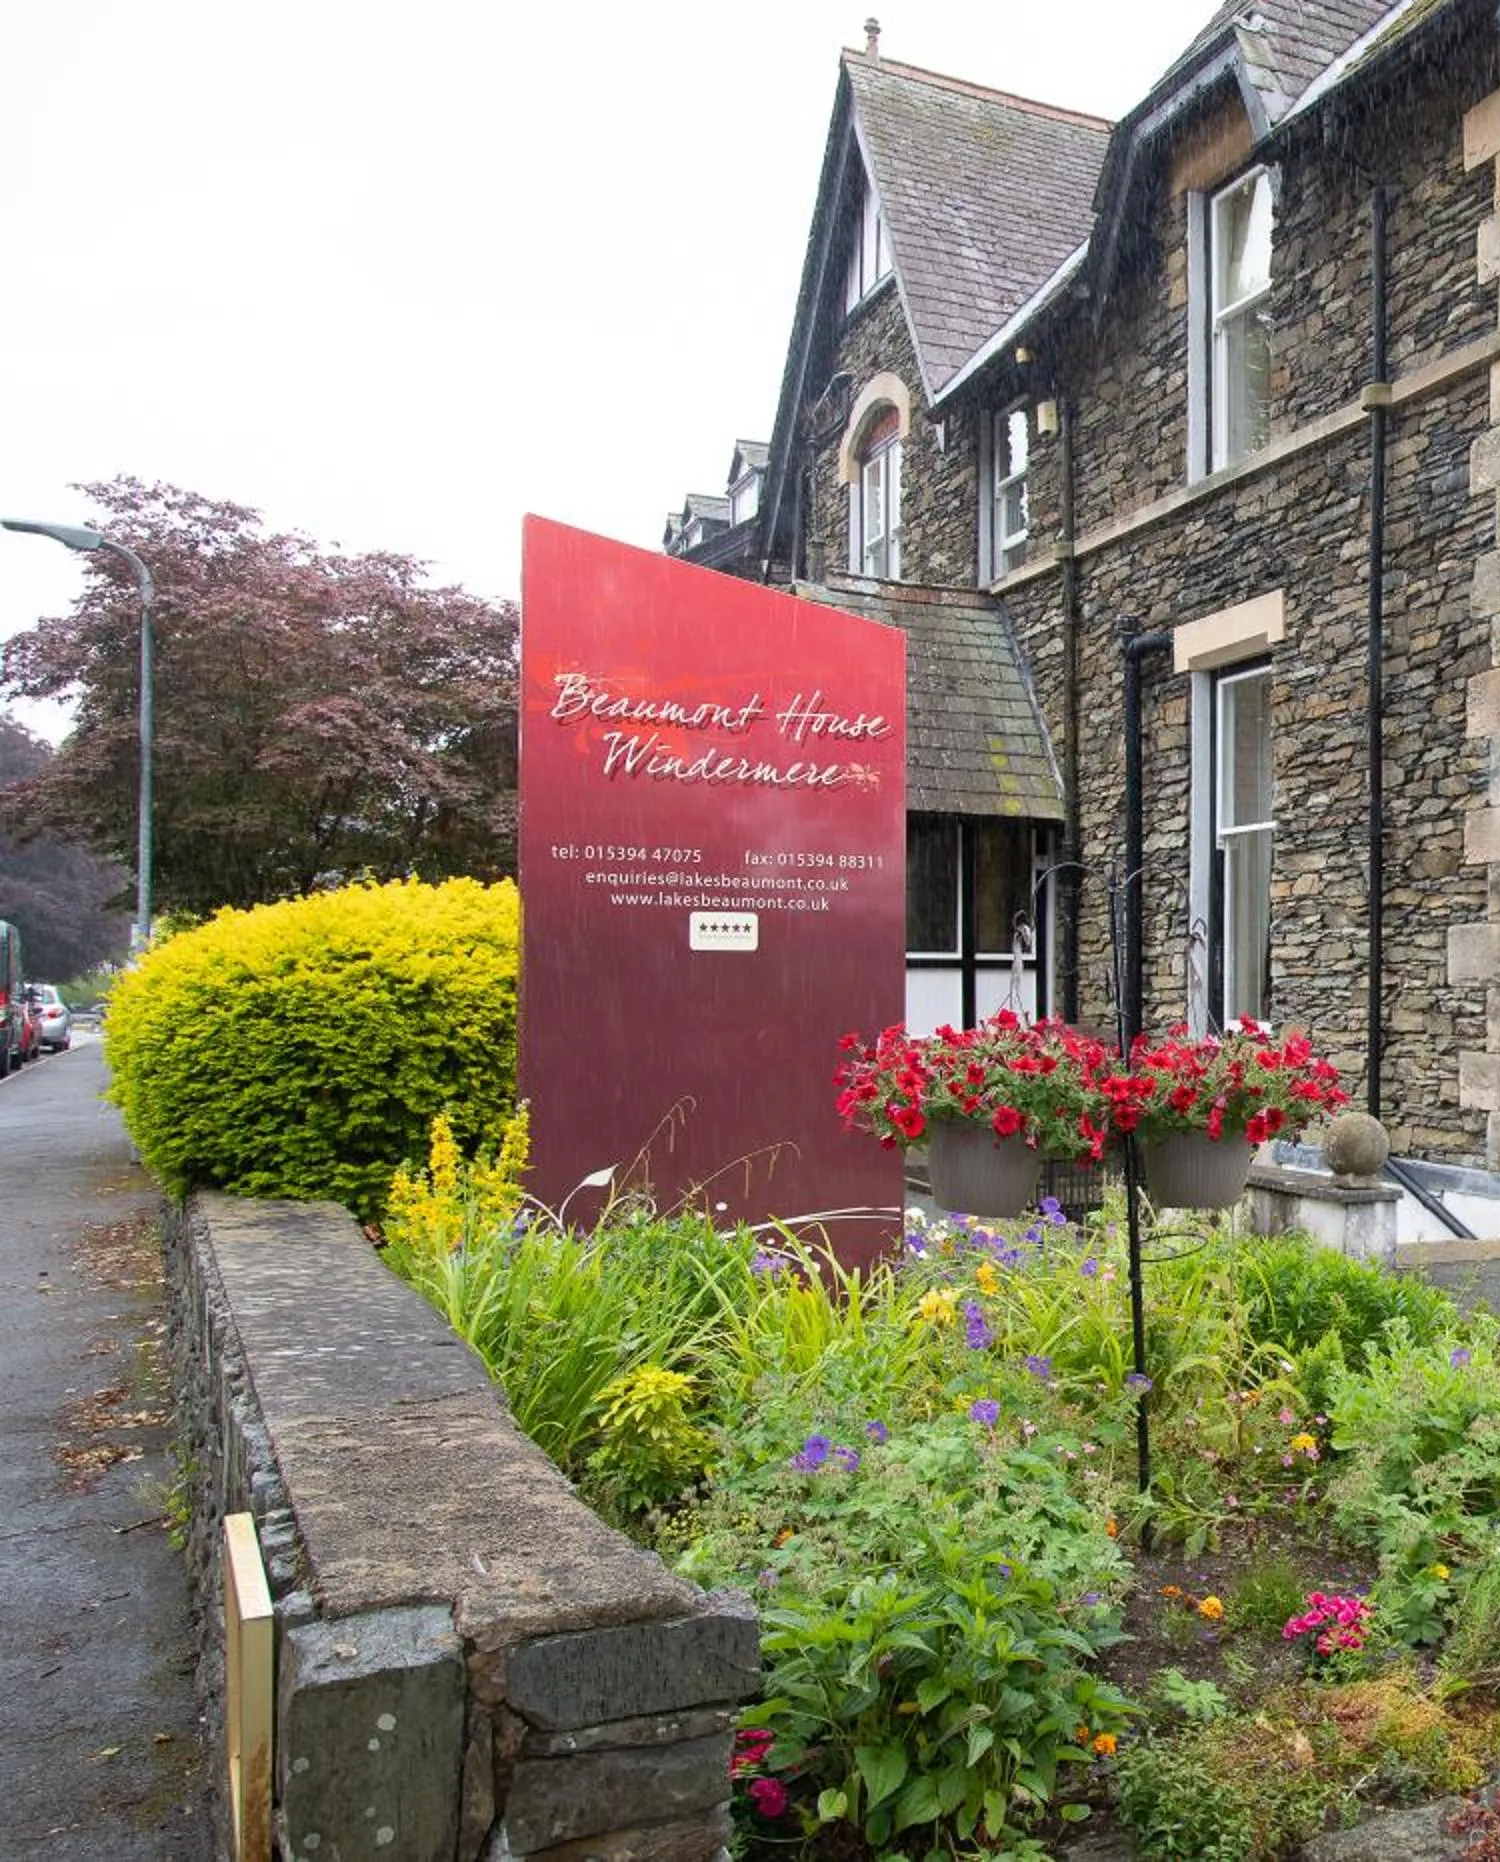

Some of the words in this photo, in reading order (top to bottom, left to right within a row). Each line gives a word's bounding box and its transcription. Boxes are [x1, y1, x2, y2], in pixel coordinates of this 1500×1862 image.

[551, 673, 762, 730] Beaumont
[776, 690, 890, 740] House
[603, 732, 844, 786] Windermere
[551, 844, 579, 859] tel:
[585, 845, 646, 862] 015394
[652, 848, 702, 863] 47075
[744, 850, 773, 865] fax:
[777, 852, 834, 868] 015394
[586, 871, 849, 891] enquiries@lakesbeaumont.co.uk
[610, 892, 830, 911] www.lakesbeaumont.co.uk
